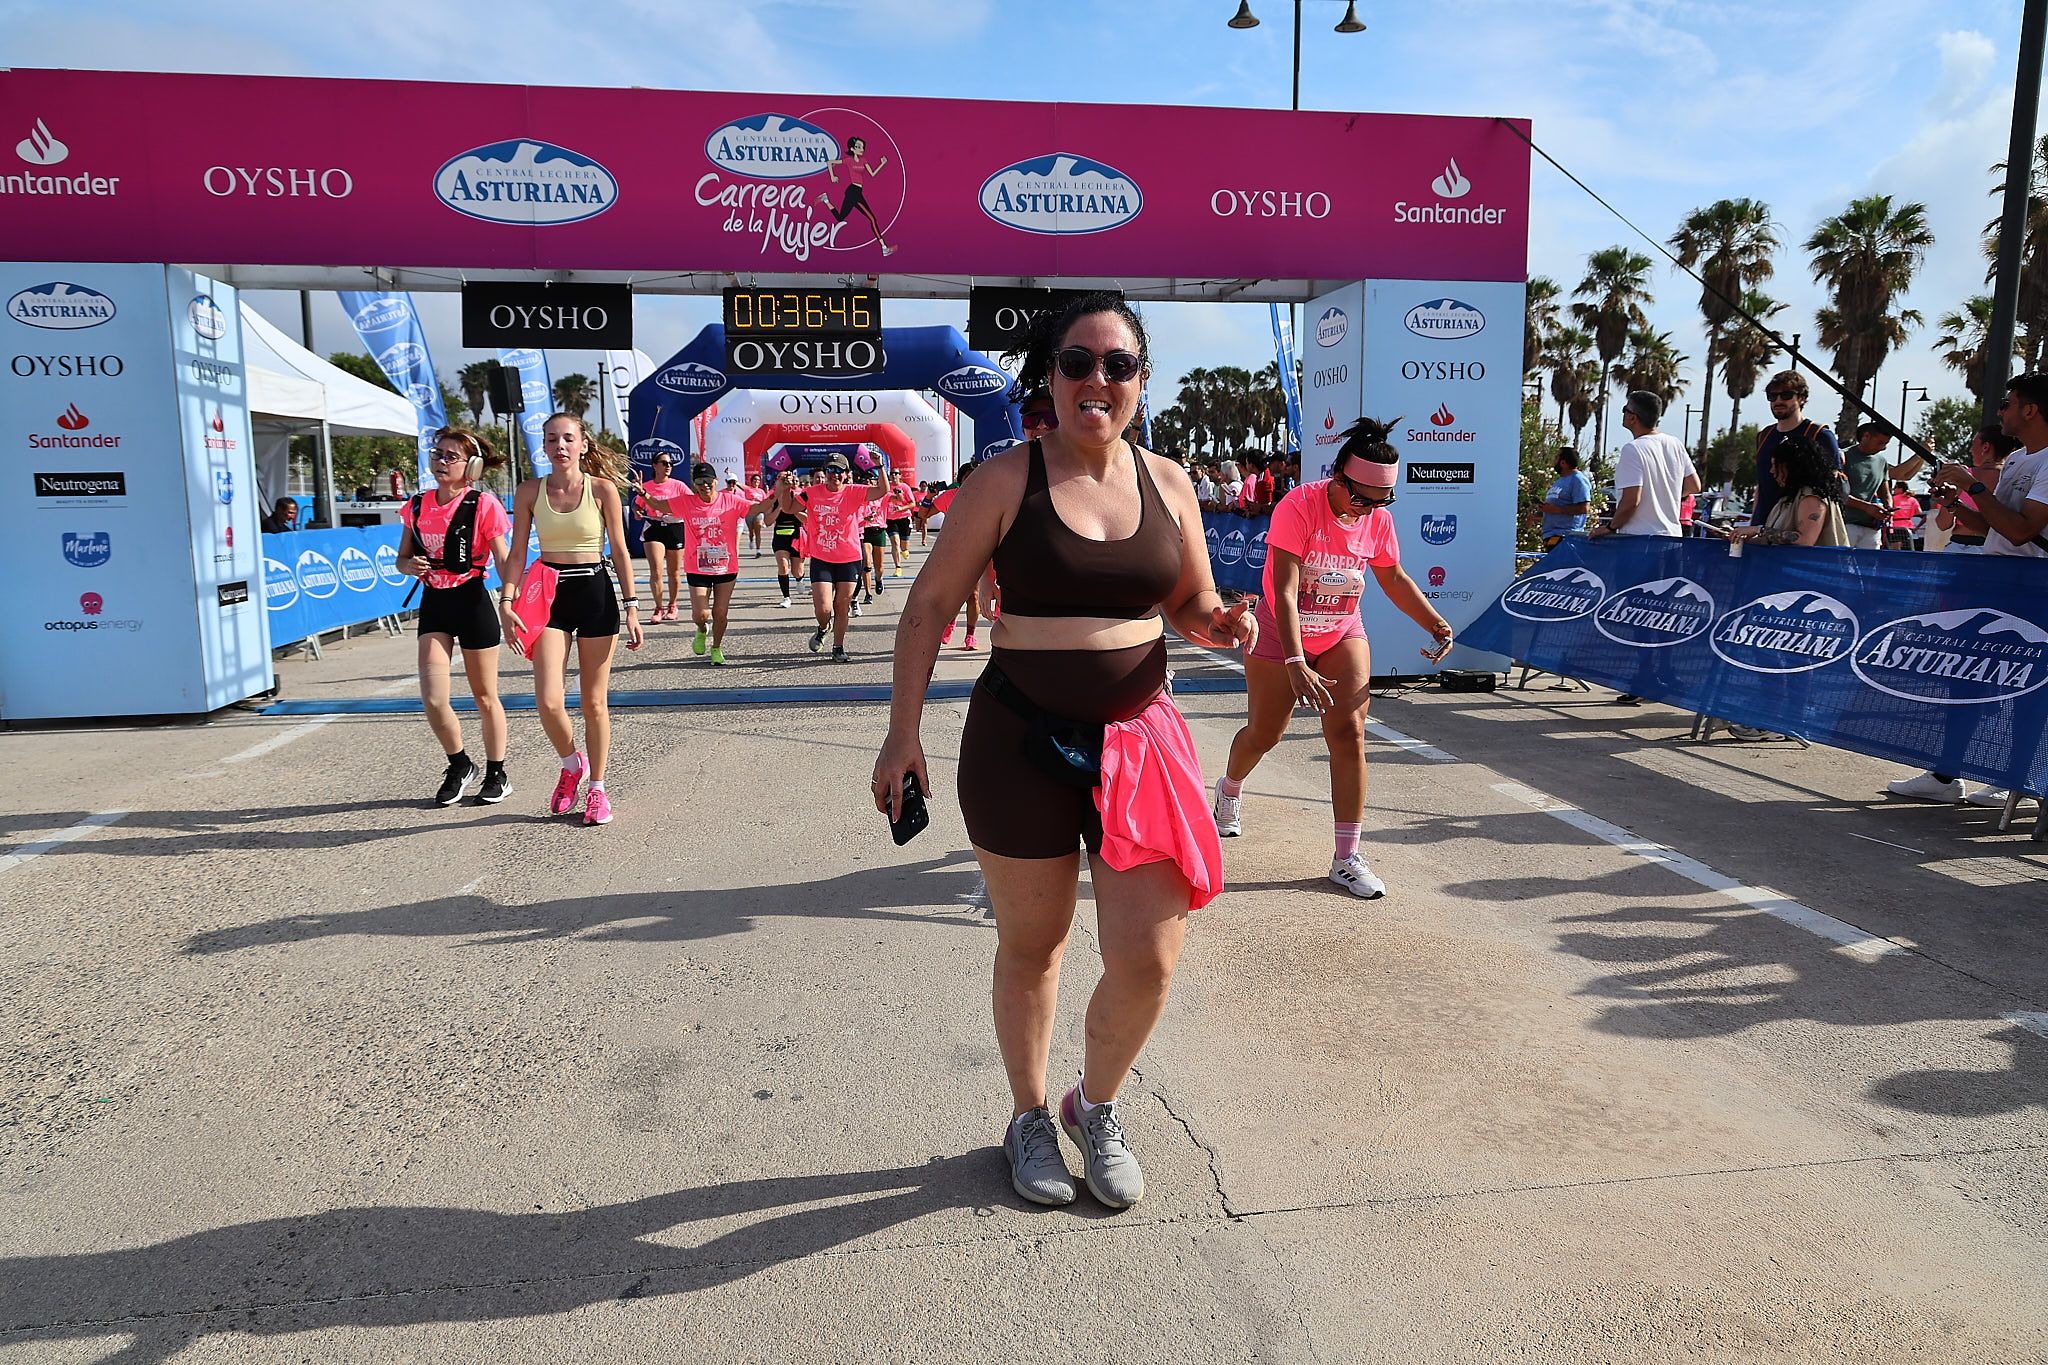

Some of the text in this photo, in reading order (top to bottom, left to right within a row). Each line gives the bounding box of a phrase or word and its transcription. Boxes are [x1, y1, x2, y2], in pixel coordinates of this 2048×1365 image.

[716, 136, 830, 163] ASTURIANA
[203, 165, 353, 199] OYSHO
[476, 167, 598, 179] CENTRAL LECHERA
[450, 169, 605, 204] ASTURIANA
[694, 172, 806, 209] Carrera
[1017, 181, 1125, 191] CENTRAL LECHERA
[992, 182, 1131, 214] ASTURIANA
[1210, 188, 1331, 219] OYSHO
[722, 209, 763, 233] de la
[1393, 201, 1506, 225] Santander
[761, 205, 848, 262] Mujer
[16, 299, 109, 318] ASTURIANA
[489, 304, 608, 331] OYSHO
[734, 294, 870, 328] 00:36:46
[1410, 312, 1479, 329] ASTURIANA
[11, 355, 124, 377] OYSHO
[732, 340, 876, 371] OYSHO
[660, 373, 721, 388] ASTURIANA
[1313, 364, 1348, 388] OYSHO
[1401, 360, 1485, 381] OYSHO
[944, 378, 1002, 390] ASTURIANA
[779, 393, 878, 415] OYSHO
[721, 416, 752, 424] OYSHO
[782, 423, 867, 433] Sports Santander
[28, 433, 121, 449] Santander
[1407, 428, 1476, 442] Santander
[709, 456, 738, 464] OYSHO
[1411, 466, 1470, 482] Neutrogena
[40, 477, 120, 494] Neutrogena
[1422, 521, 1456, 537] Marlene
[1303, 550, 1362, 570] CARRERA
[1315, 594, 1341, 605] 016
[1440, 591, 1474, 602] energy
[1506, 582, 1591, 614] ASTURIANA
[44, 619, 144, 633] octopus energy
[1598, 596, 1701, 636] ASTURIANA
[1752, 614, 1848, 634] CENTRAL LECHERA
[1716, 613, 1843, 660] ASTURIANA
[1905, 632, 2042, 659] CENTRAL LECHERA
[1858, 631, 2035, 689] ASTURIANA
